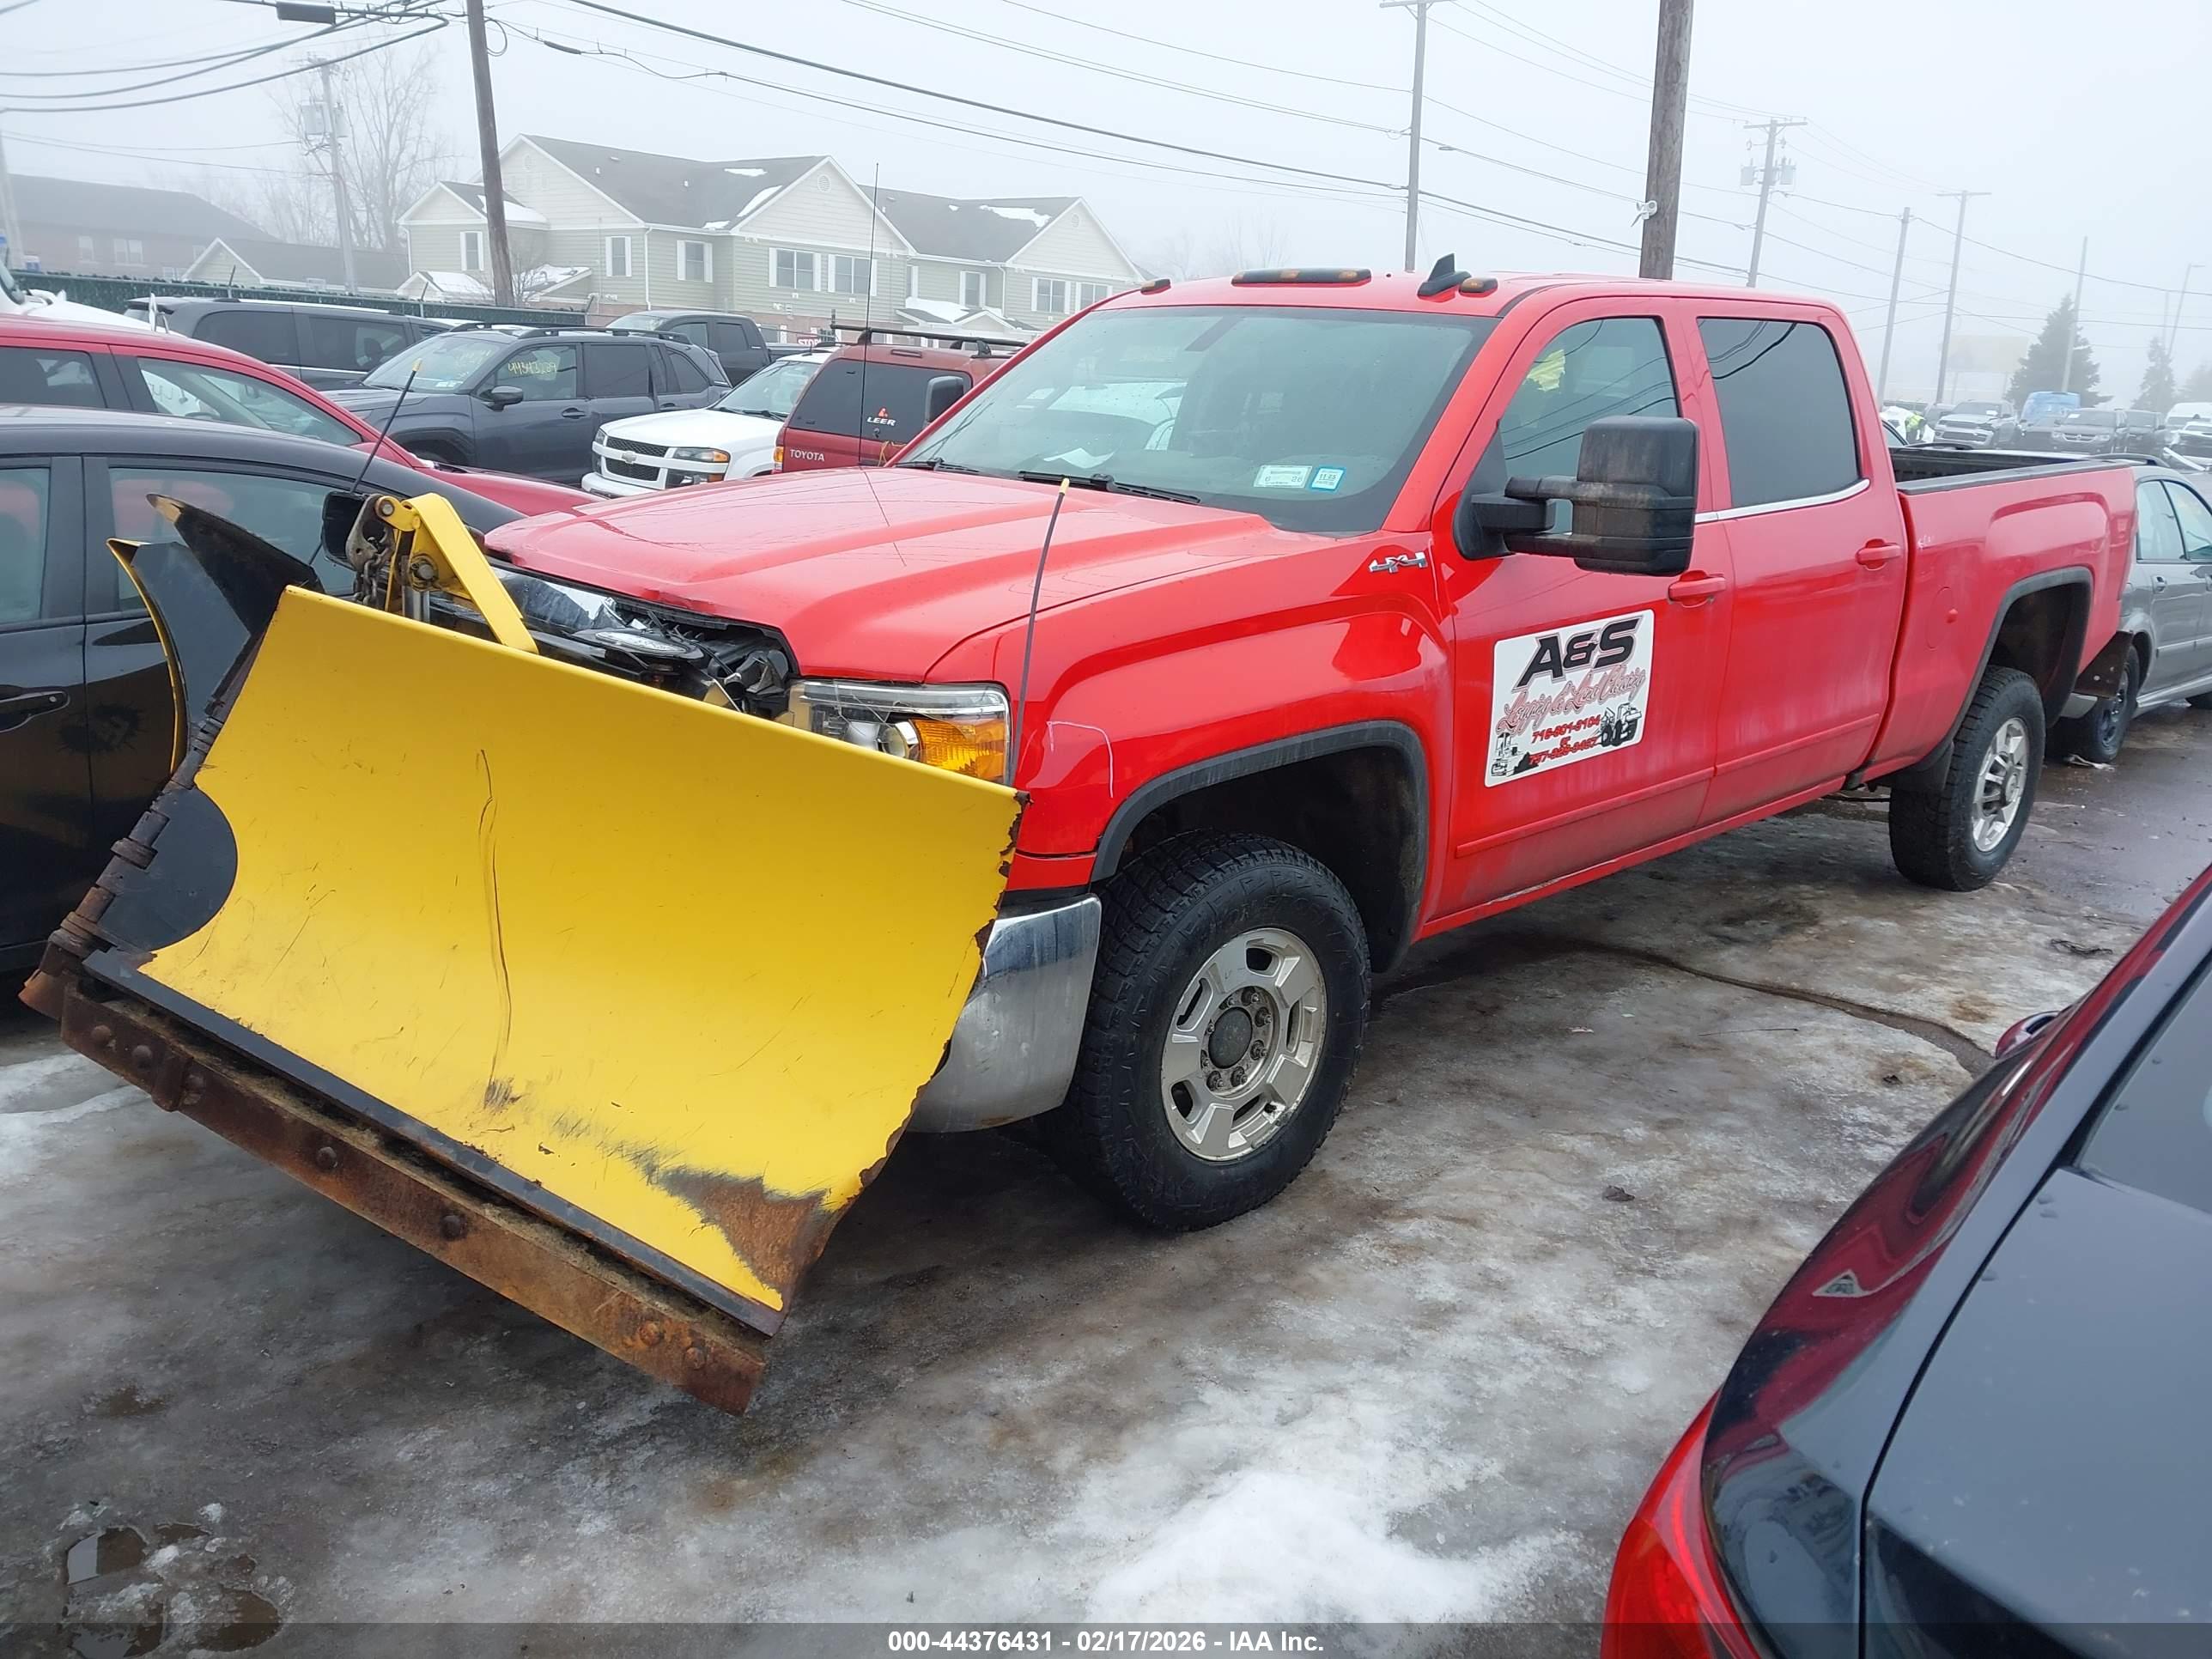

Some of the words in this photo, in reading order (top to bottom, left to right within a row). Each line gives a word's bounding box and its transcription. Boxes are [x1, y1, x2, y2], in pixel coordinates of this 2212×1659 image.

[866, 416, 896, 427] LEER
[789, 449, 825, 462] TOYOTA
[1514, 616, 1641, 690] A&S
